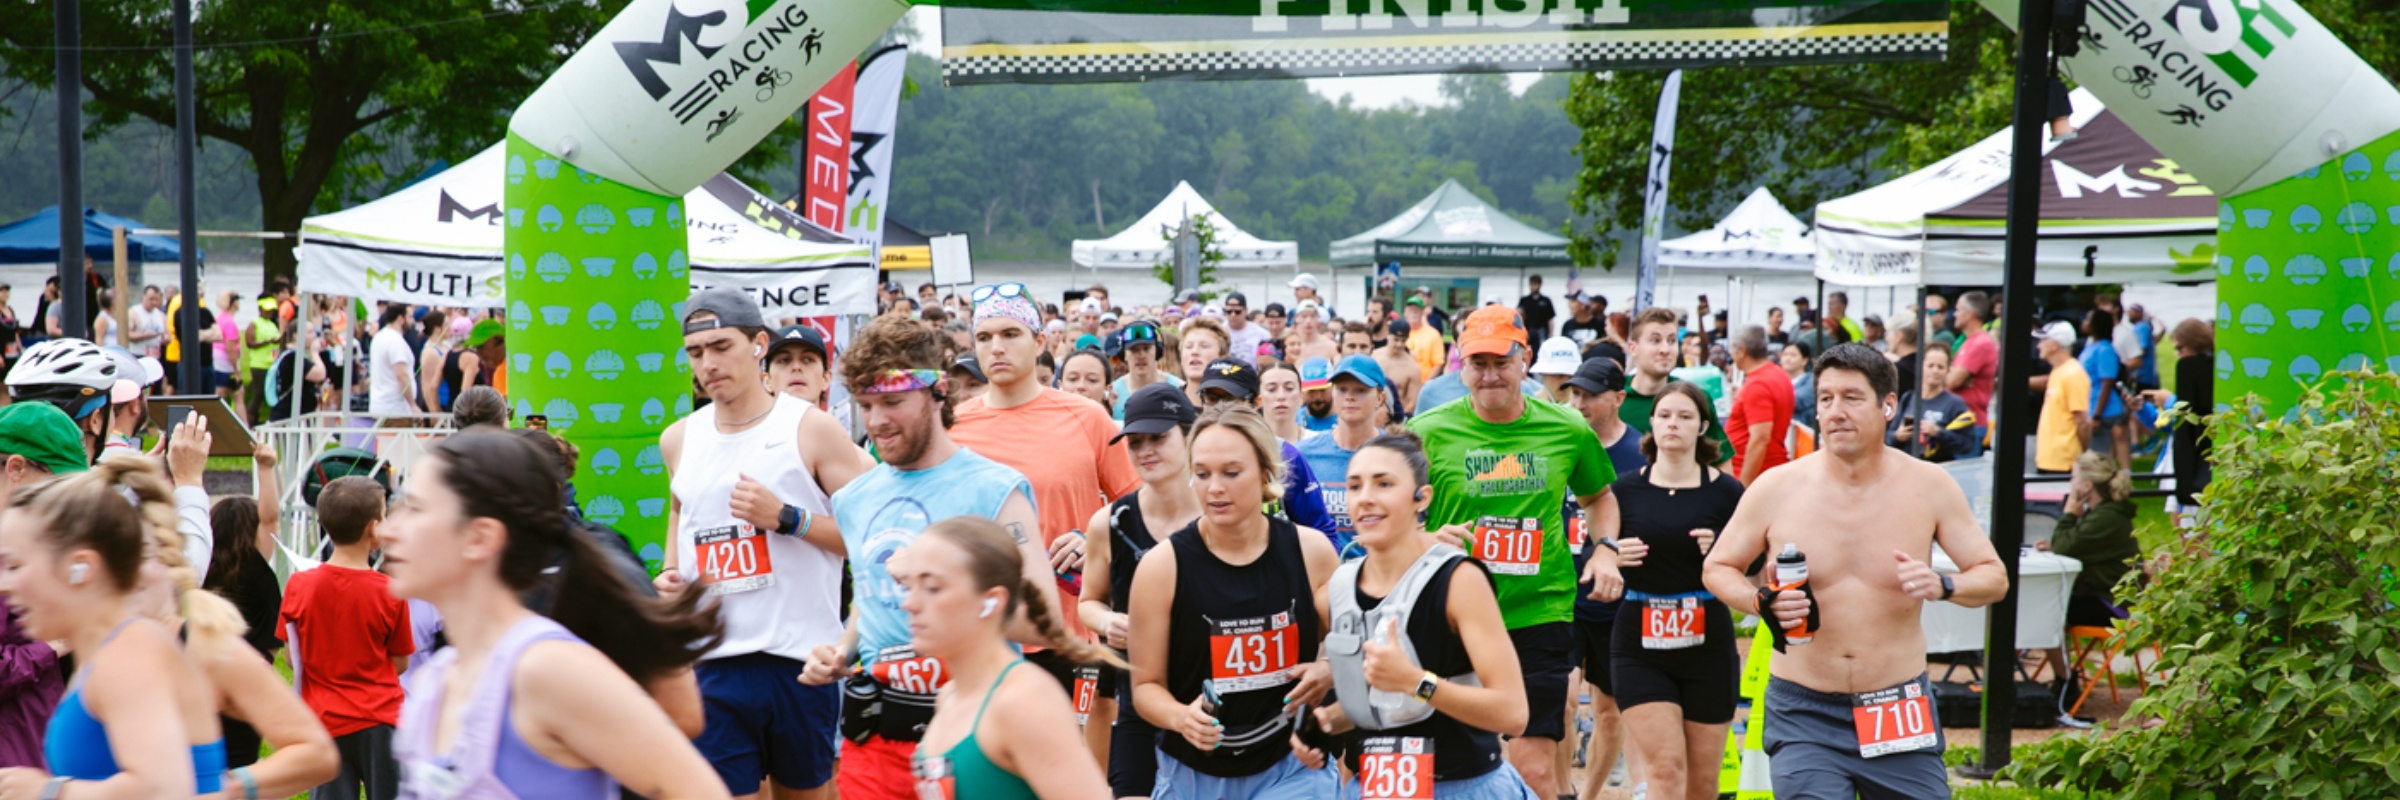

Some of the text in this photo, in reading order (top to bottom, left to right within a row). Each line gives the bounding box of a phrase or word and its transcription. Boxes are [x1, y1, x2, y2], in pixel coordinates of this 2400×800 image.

[708, 3, 809, 94] RACING
[2123, 20, 2233, 112] RACING
[366, 266, 472, 298] MULTI
[1322, 490, 1348, 505] TOU
[1484, 529, 1532, 562] 610
[1577, 519, 1588, 544] 8
[706, 539, 757, 580] 420
[1650, 609, 1695, 638] 642
[1225, 630, 1285, 675] 431
[888, 656, 942, 694] 462
[1866, 700, 1924, 741] 710
[1363, 755, 1418, 798] 258
